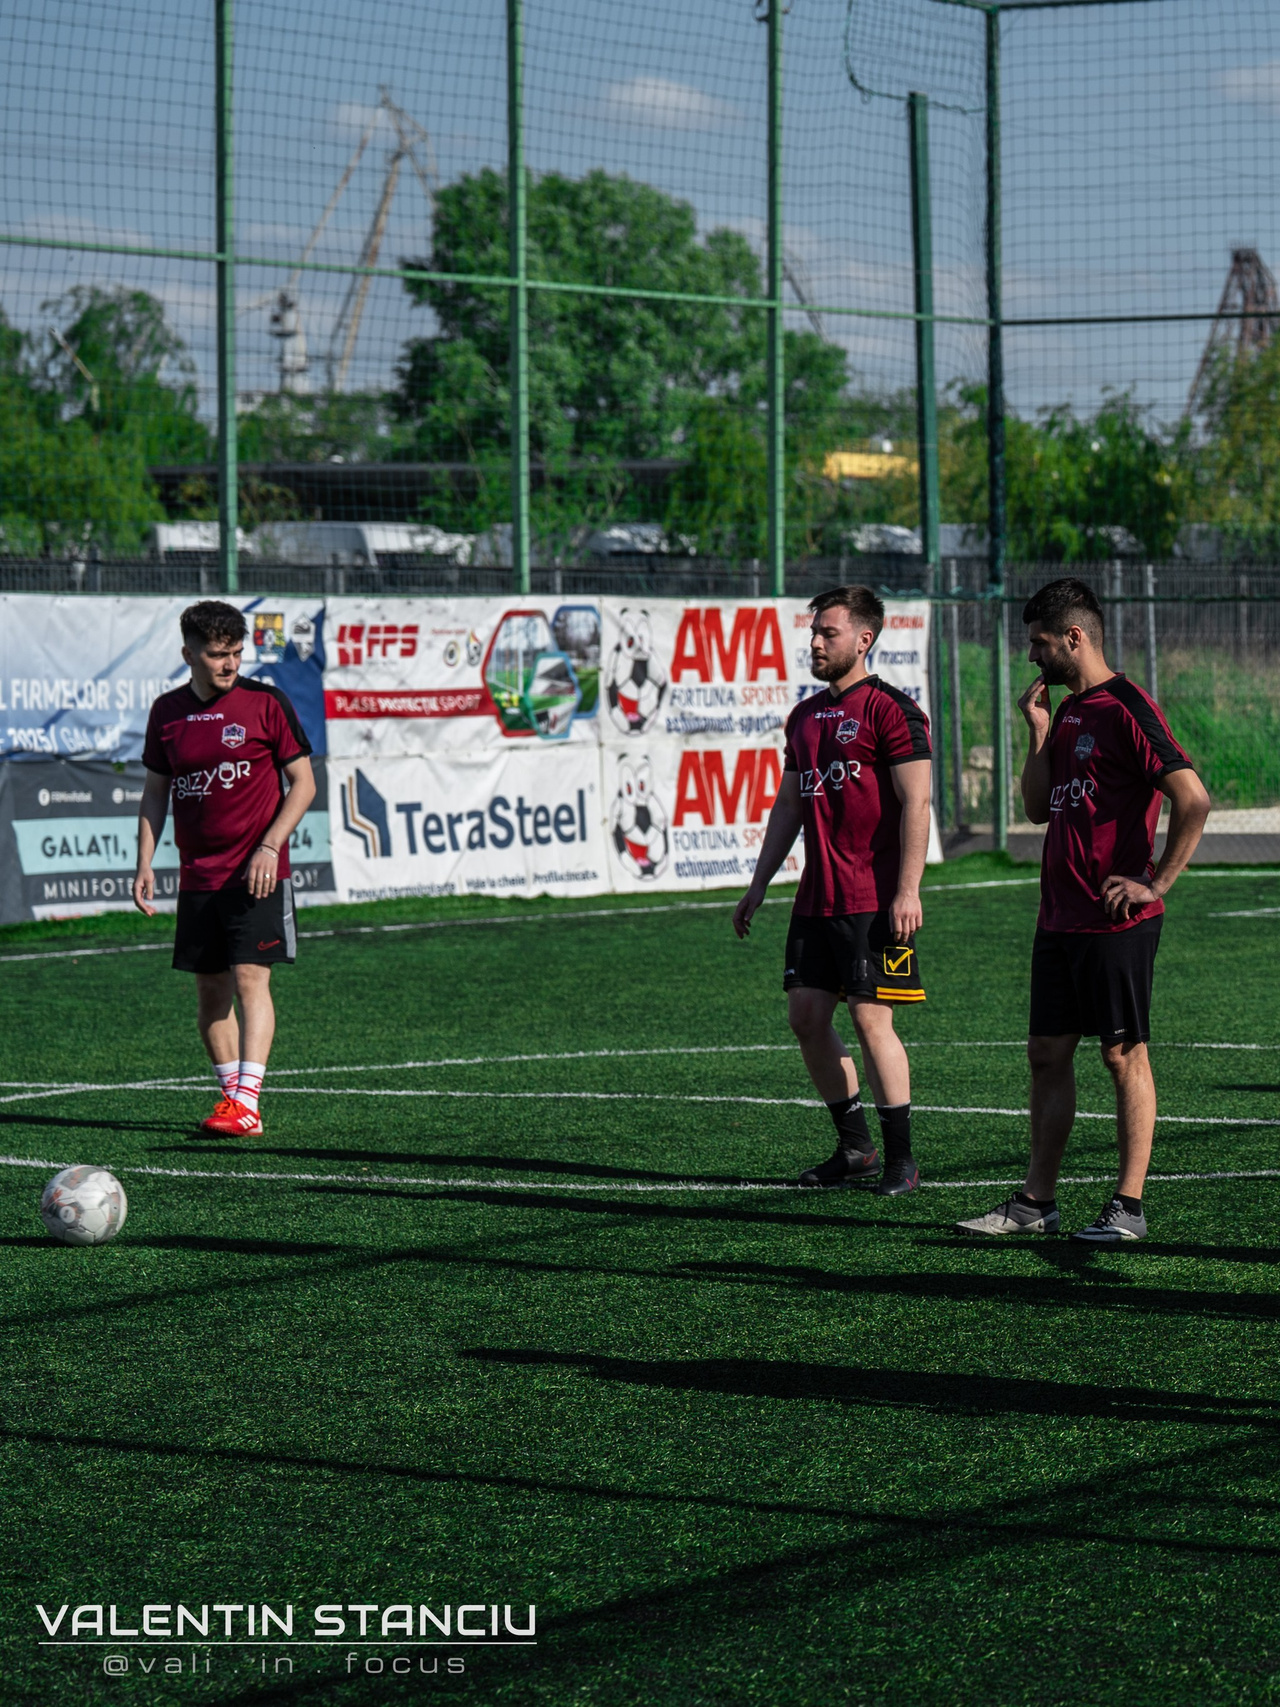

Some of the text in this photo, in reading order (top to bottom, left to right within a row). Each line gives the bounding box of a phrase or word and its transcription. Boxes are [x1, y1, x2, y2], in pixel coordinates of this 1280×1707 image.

[367, 624, 420, 658] FPS
[670, 606, 788, 683] AMA
[11, 679, 110, 710] FIRMELOR
[334, 695, 378, 713] PLASE
[439, 694, 482, 711] SPORT
[669, 686, 736, 707] FORTUNA
[741, 686, 790, 706] SPORTS
[187, 713, 225, 722] GIVOVA
[672, 748, 785, 827] AMA
[395, 788, 587, 855] TeraSteel
[672, 829, 740, 851] FORTUNA
